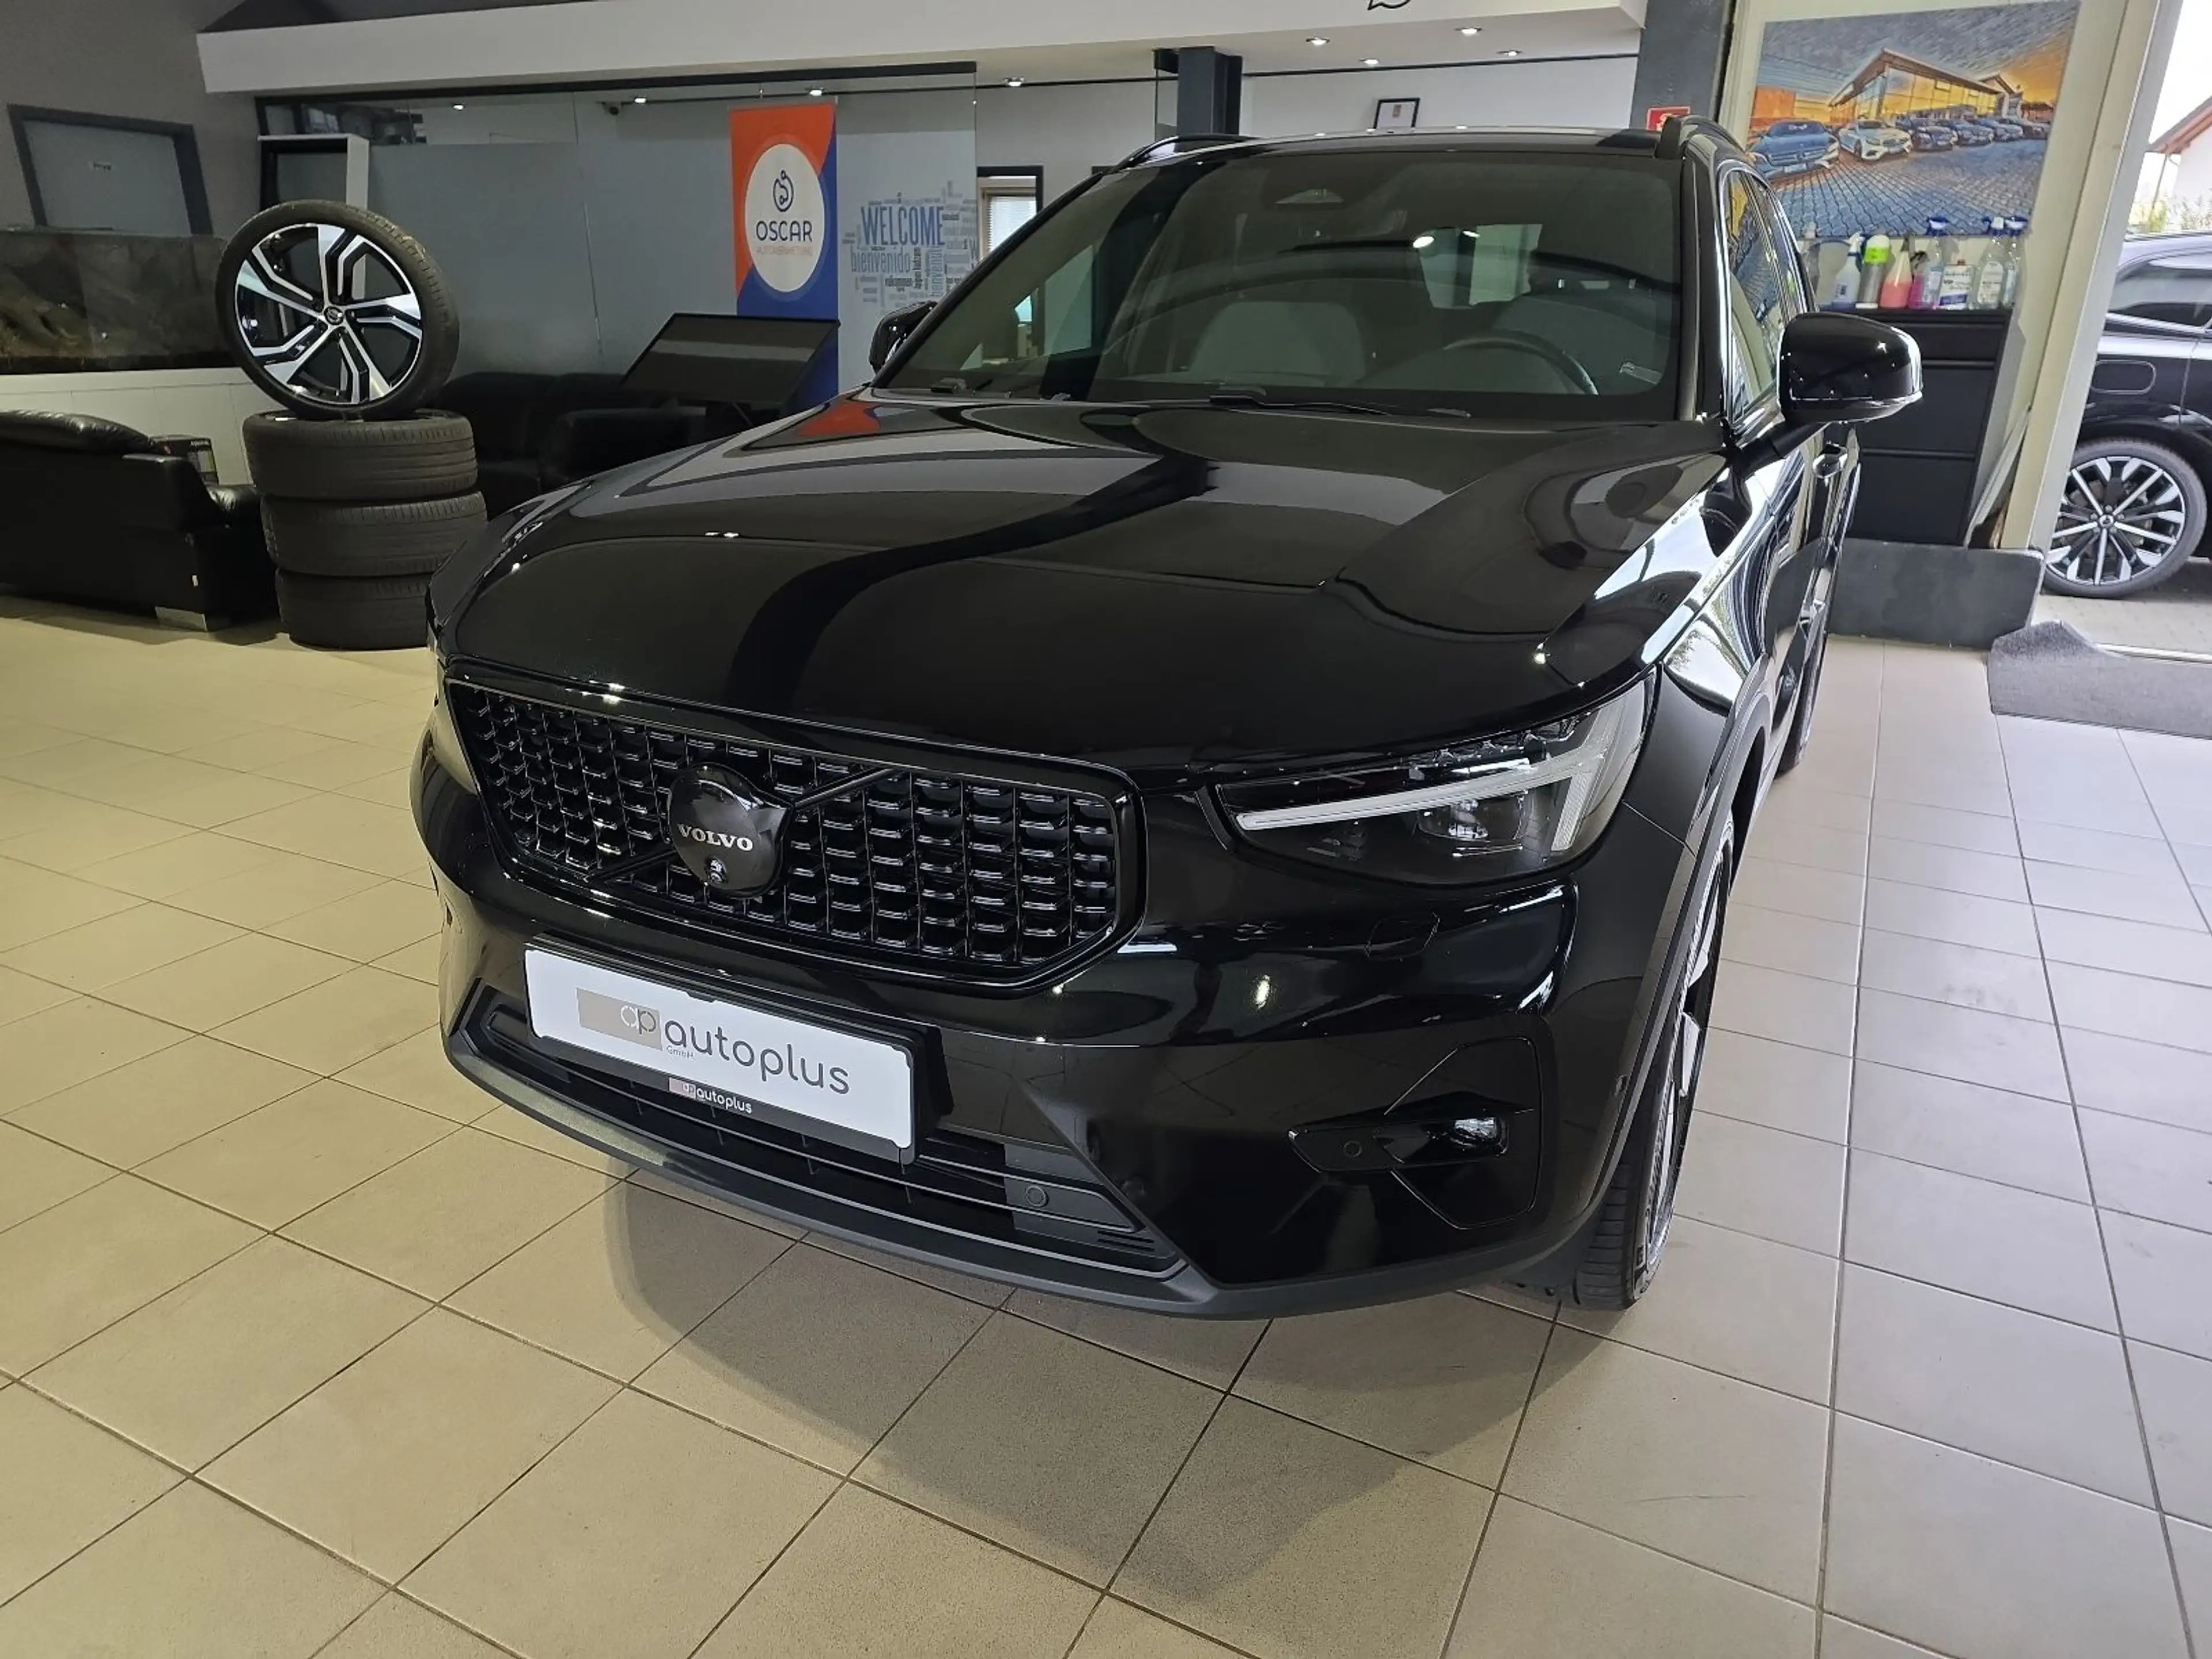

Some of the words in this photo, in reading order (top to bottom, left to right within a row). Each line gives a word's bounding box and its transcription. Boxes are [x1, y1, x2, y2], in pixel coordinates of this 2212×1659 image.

[756, 220, 812, 242] OSCAR
[861, 206, 945, 245] WELCOME
[851, 245, 911, 273] bienvenido
[678, 824, 753, 851] VOLVO
[664, 1020, 850, 1094] autoplus
[696, 1088, 752, 1113] autoplus
